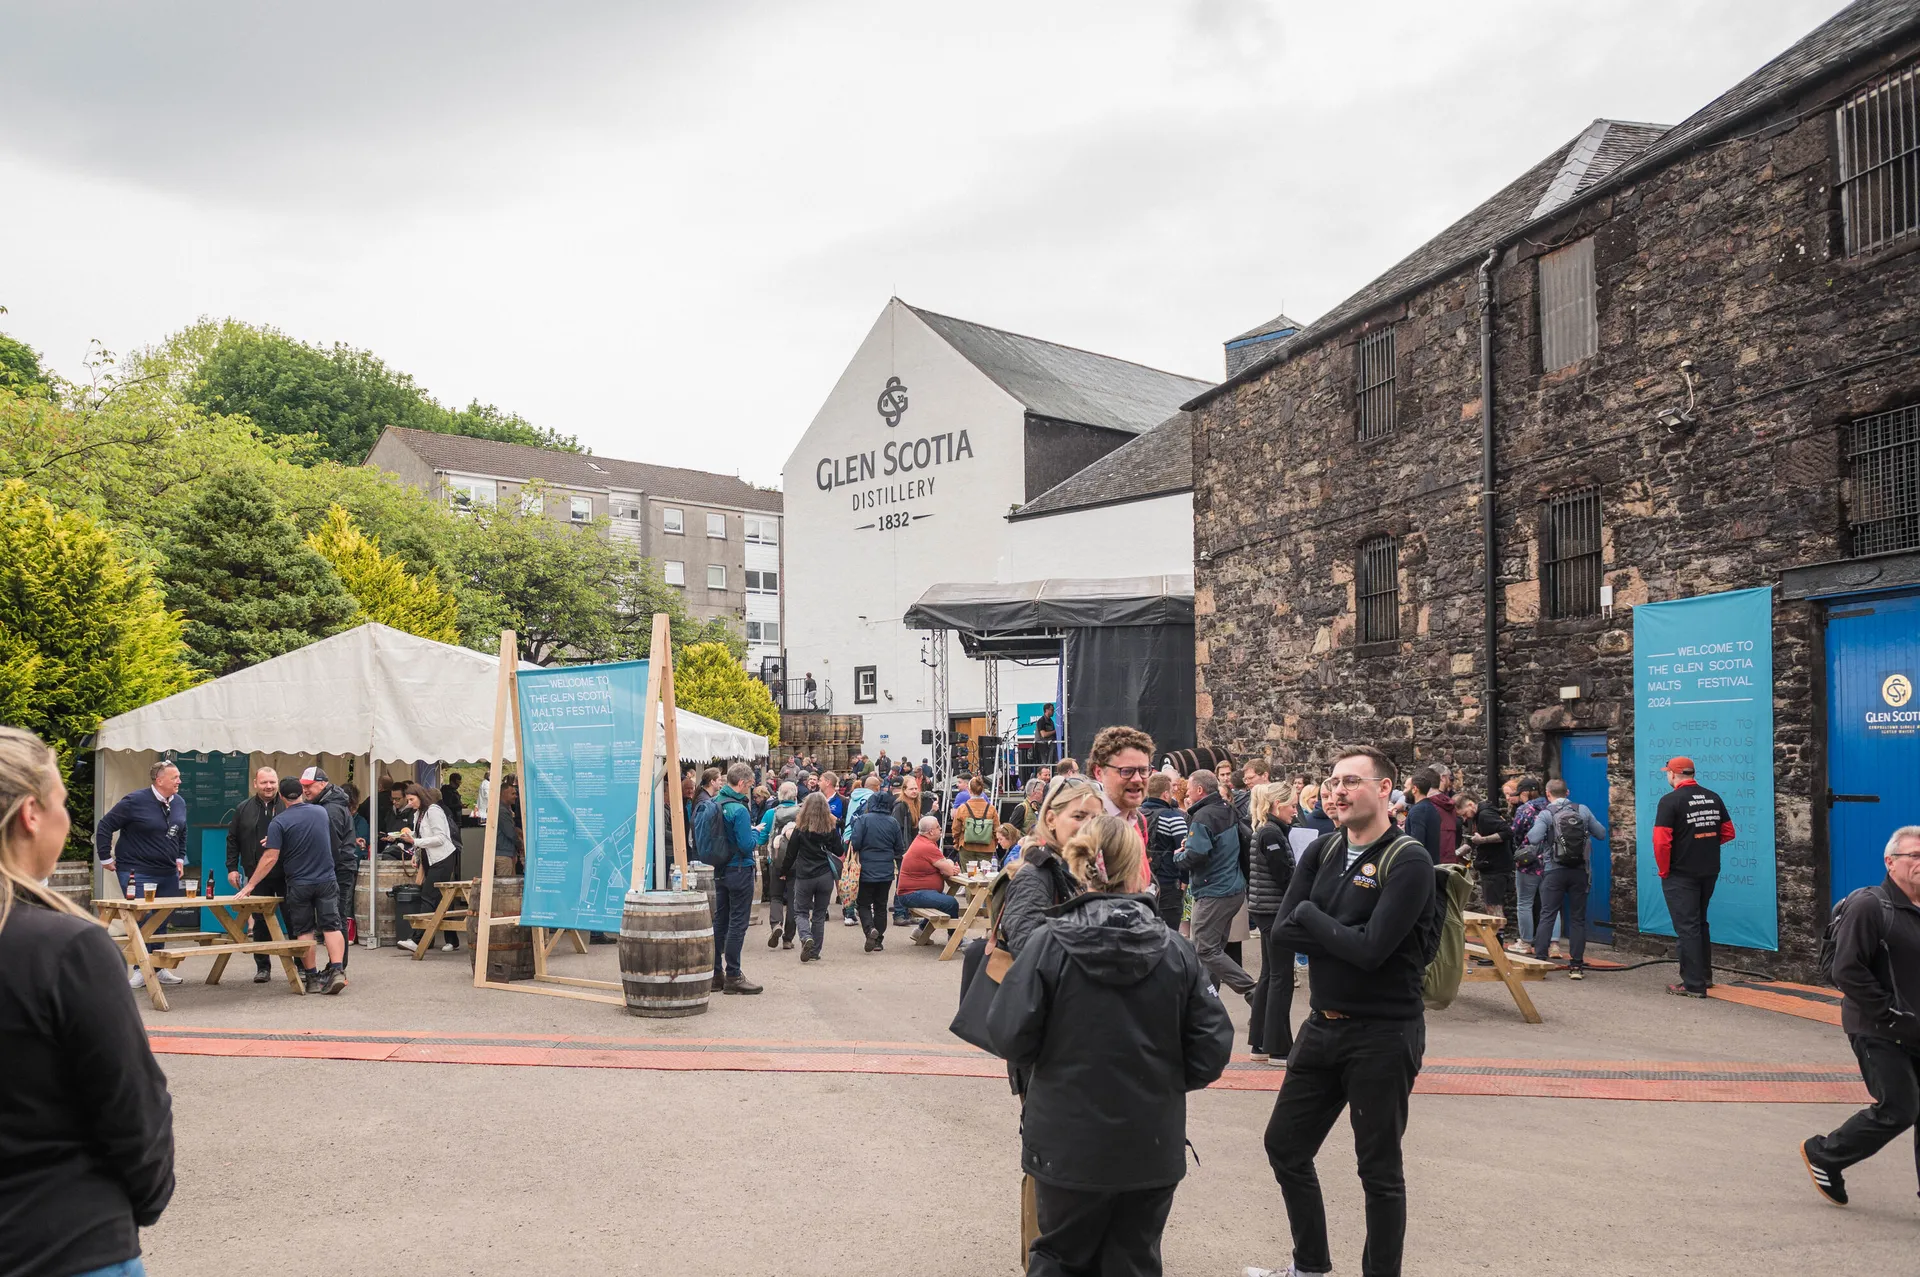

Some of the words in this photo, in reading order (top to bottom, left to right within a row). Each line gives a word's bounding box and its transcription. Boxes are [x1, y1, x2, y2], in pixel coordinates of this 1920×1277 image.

[816, 450, 876, 493] GLEN
[883, 429, 974, 476] SCOTIA
[852, 477, 935, 511] DISTILLERY
[878, 511, 909, 531] 1832
[1677, 642, 1734, 656] WELCOME
[1736, 640, 1754, 651] TO
[1648, 664, 1669, 675] THE
[1673, 662, 1703, 674] GLEN
[1709, 658, 1754, 671] SCOTIA
[550, 676, 595, 688] WELCOME
[596, 676, 610, 685] TO
[1648, 680, 1682, 691] MALTS
[1697, 676, 1754, 689] FESTIVAL
[529, 695, 549, 703] THE
[550, 693, 575, 703] GLEN
[576, 690, 612, 701] SCOTIA
[1647, 697, 1671, 708] 2024
[531, 707, 564, 717] MALTS
[566, 705, 614, 716] FESTIVAL
[1865, 711, 1891, 723] GLEN
[1892, 710, 1920, 722] SCOTI
[532, 722, 555, 731] 2024
[1648, 722, 1656, 731] A
[1672, 720, 1718, 731] CHEERS
[1736, 719, 1753, 729] TO
[1648, 736, 1754, 748] ADVENTUROUS
[1727, 753, 1754, 764] YOU
[1697, 770, 1755, 781] CROSSING
[1735, 788, 1756, 799] AIR
[1730, 856, 1758, 868] OUR
